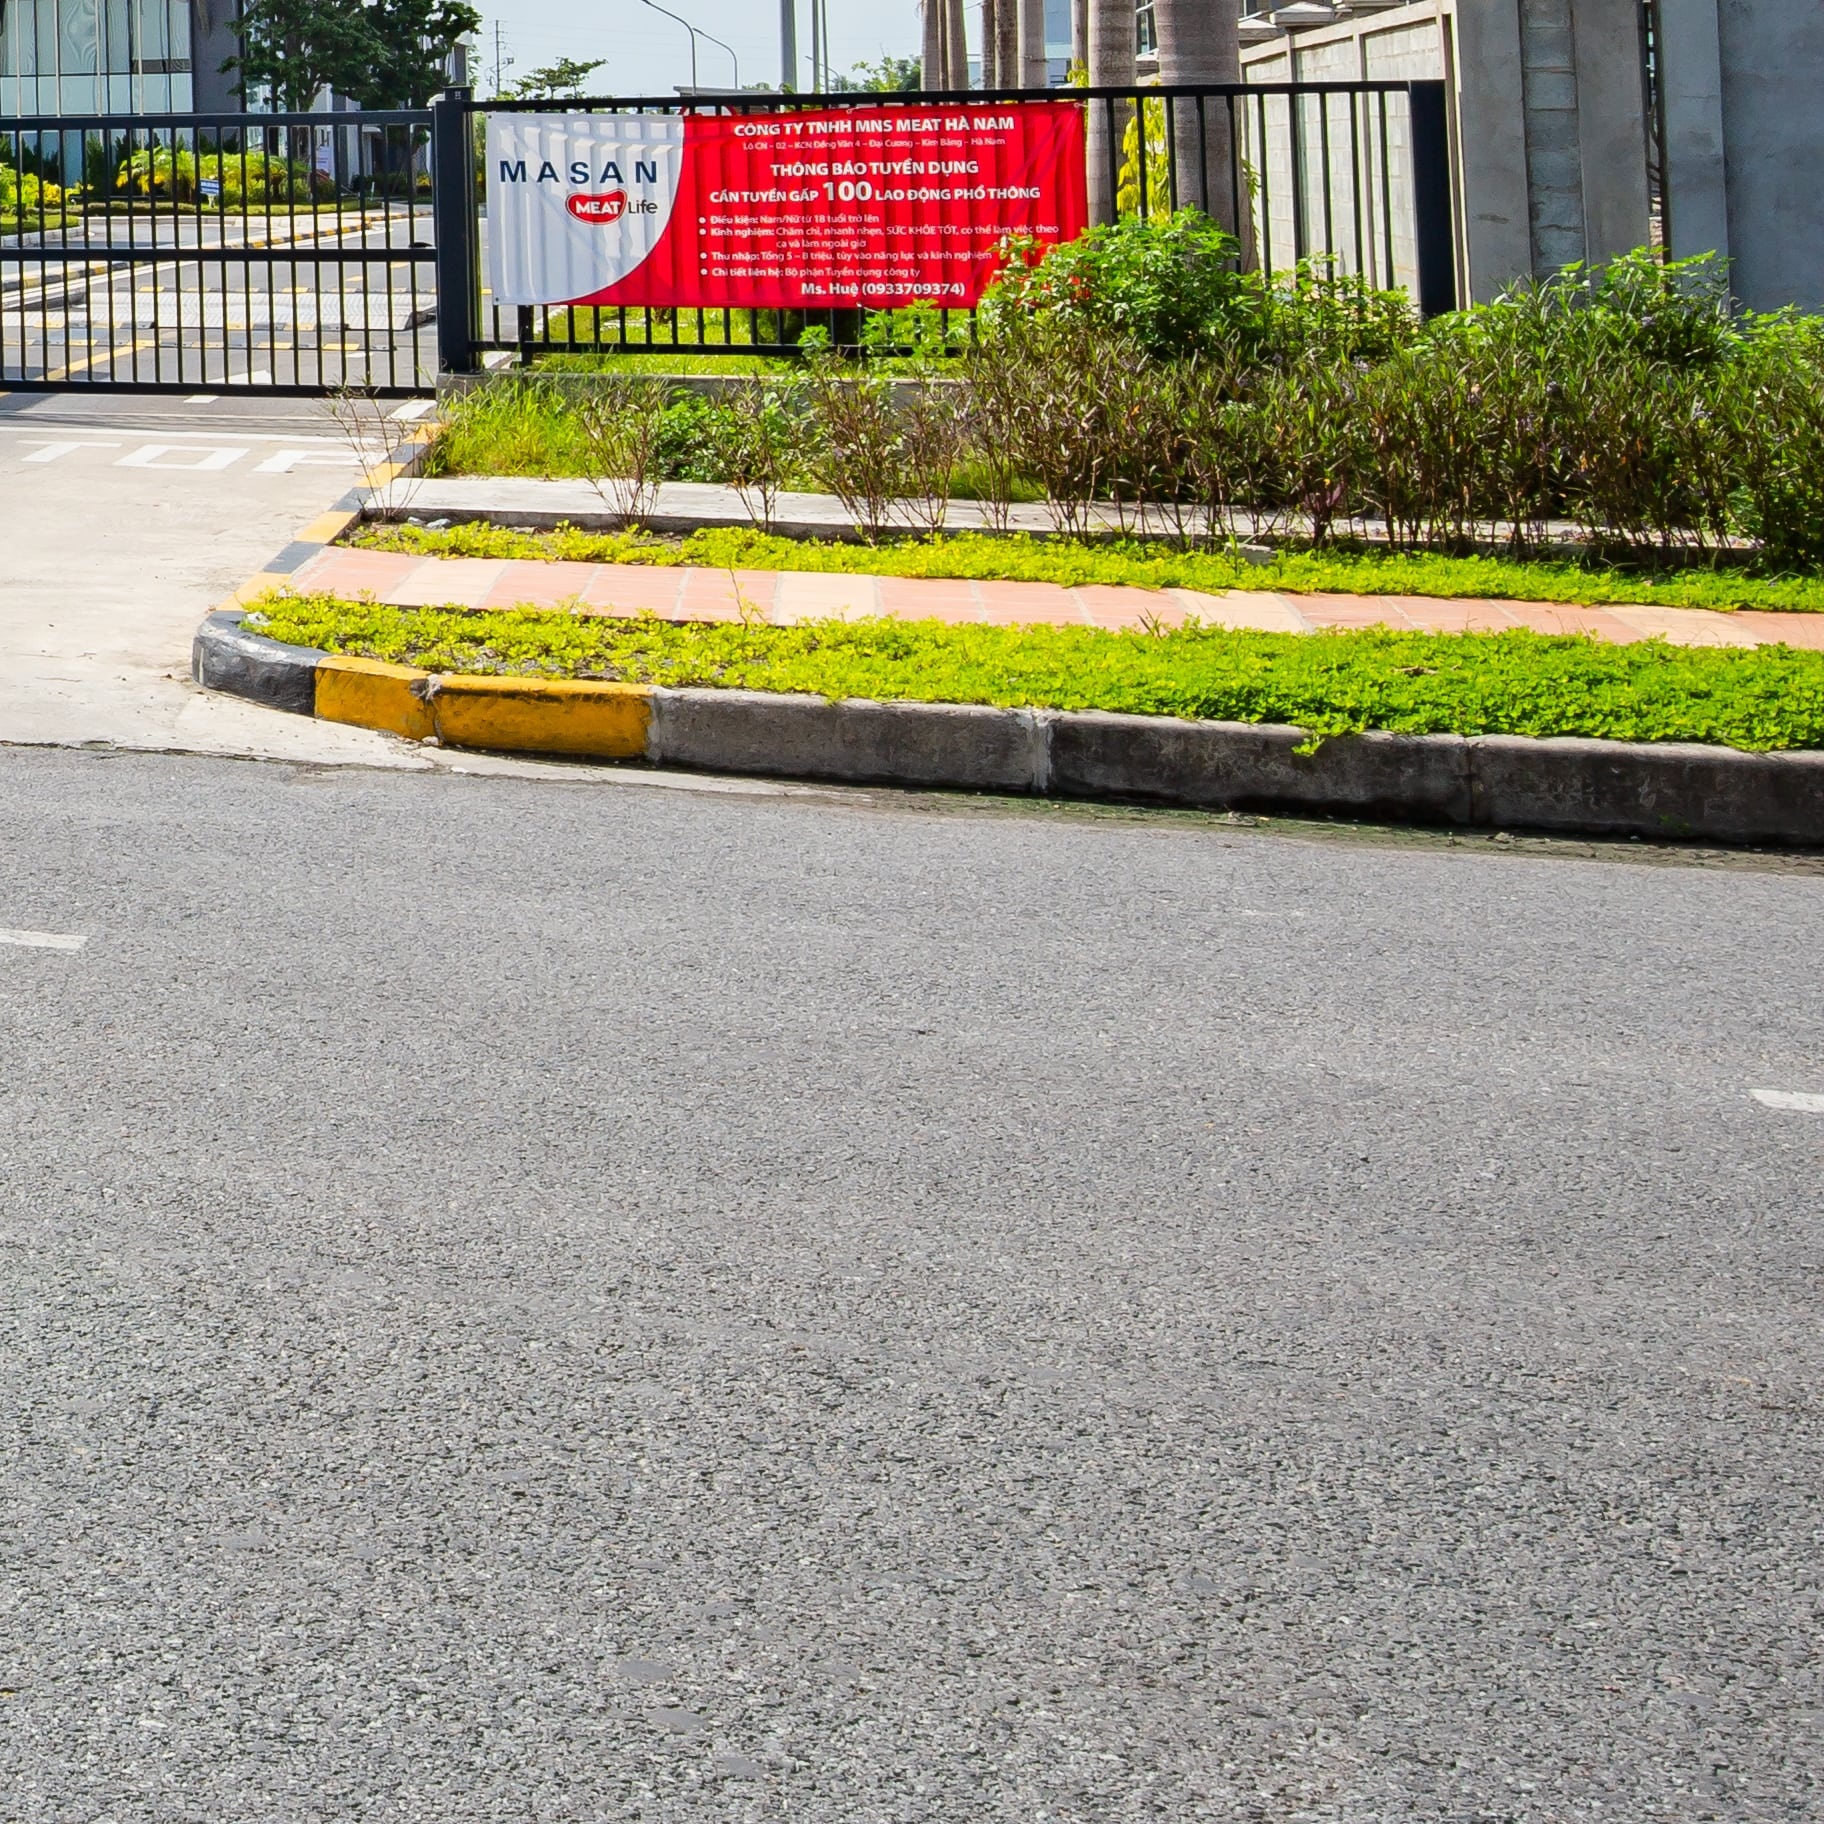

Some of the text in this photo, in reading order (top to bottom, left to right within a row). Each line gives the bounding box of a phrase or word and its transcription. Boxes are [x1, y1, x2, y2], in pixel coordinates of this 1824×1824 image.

[734, 115, 1015, 136] CÔNG TY TNHH MNS MEAT HÀ NAM
[985, 137, 1005, 145] Nam
[500, 160, 657, 185] MASAN
[770, 161, 829, 176] THÔNG
[832, 160, 867, 175] BÁO
[928, 161, 979, 177] DỤNG
[789, 188, 819, 202] GẤP
[823, 181, 872, 201] 100
[875, 189, 904, 201] LAO
[907, 187, 951, 203] ĐỘNG
[987, 186, 1041, 200] THÔNG
[575, 199, 658, 215] MEAT Life
[814, 215, 825, 223] 18
[864, 214, 879, 223] lên
[710, 227, 733, 236] Kinh
[824, 226, 854, 235] nhanh
[1035, 224, 1059, 233] theo
[789, 240, 800, 248] và
[802, 239, 820, 248] làm
[712, 252, 730, 260] Thu
[786, 251, 792, 260] 5
[854, 252, 872, 260] vào
[917, 251, 928, 260] và
[930, 251, 952, 259] kinh
[884, 267, 908, 278] công
[910, 268, 921, 278] ty
[801, 282, 965, 297] Ms. Huệ (0933709374)
